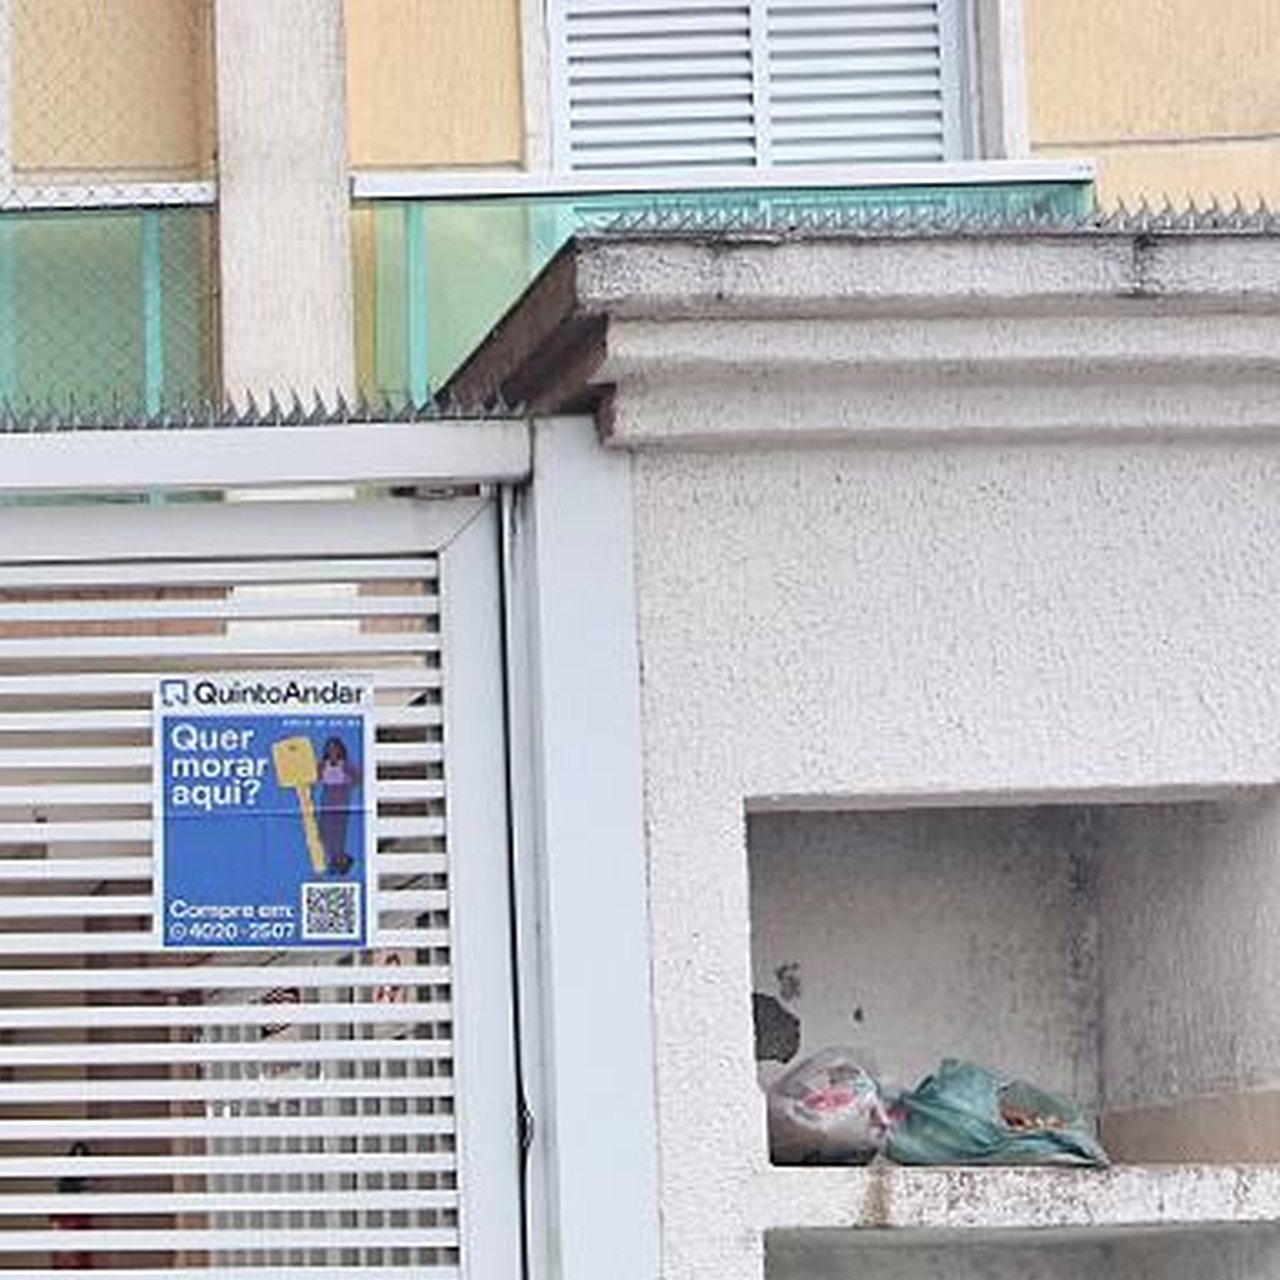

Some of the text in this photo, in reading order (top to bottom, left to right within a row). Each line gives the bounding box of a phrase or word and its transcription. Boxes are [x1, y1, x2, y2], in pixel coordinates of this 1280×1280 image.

[193, 680, 364, 705] QuintoAndar
[171, 724, 254, 750] Quer
[171, 755, 266, 778] morar
[171, 780, 261, 809] aqui?
